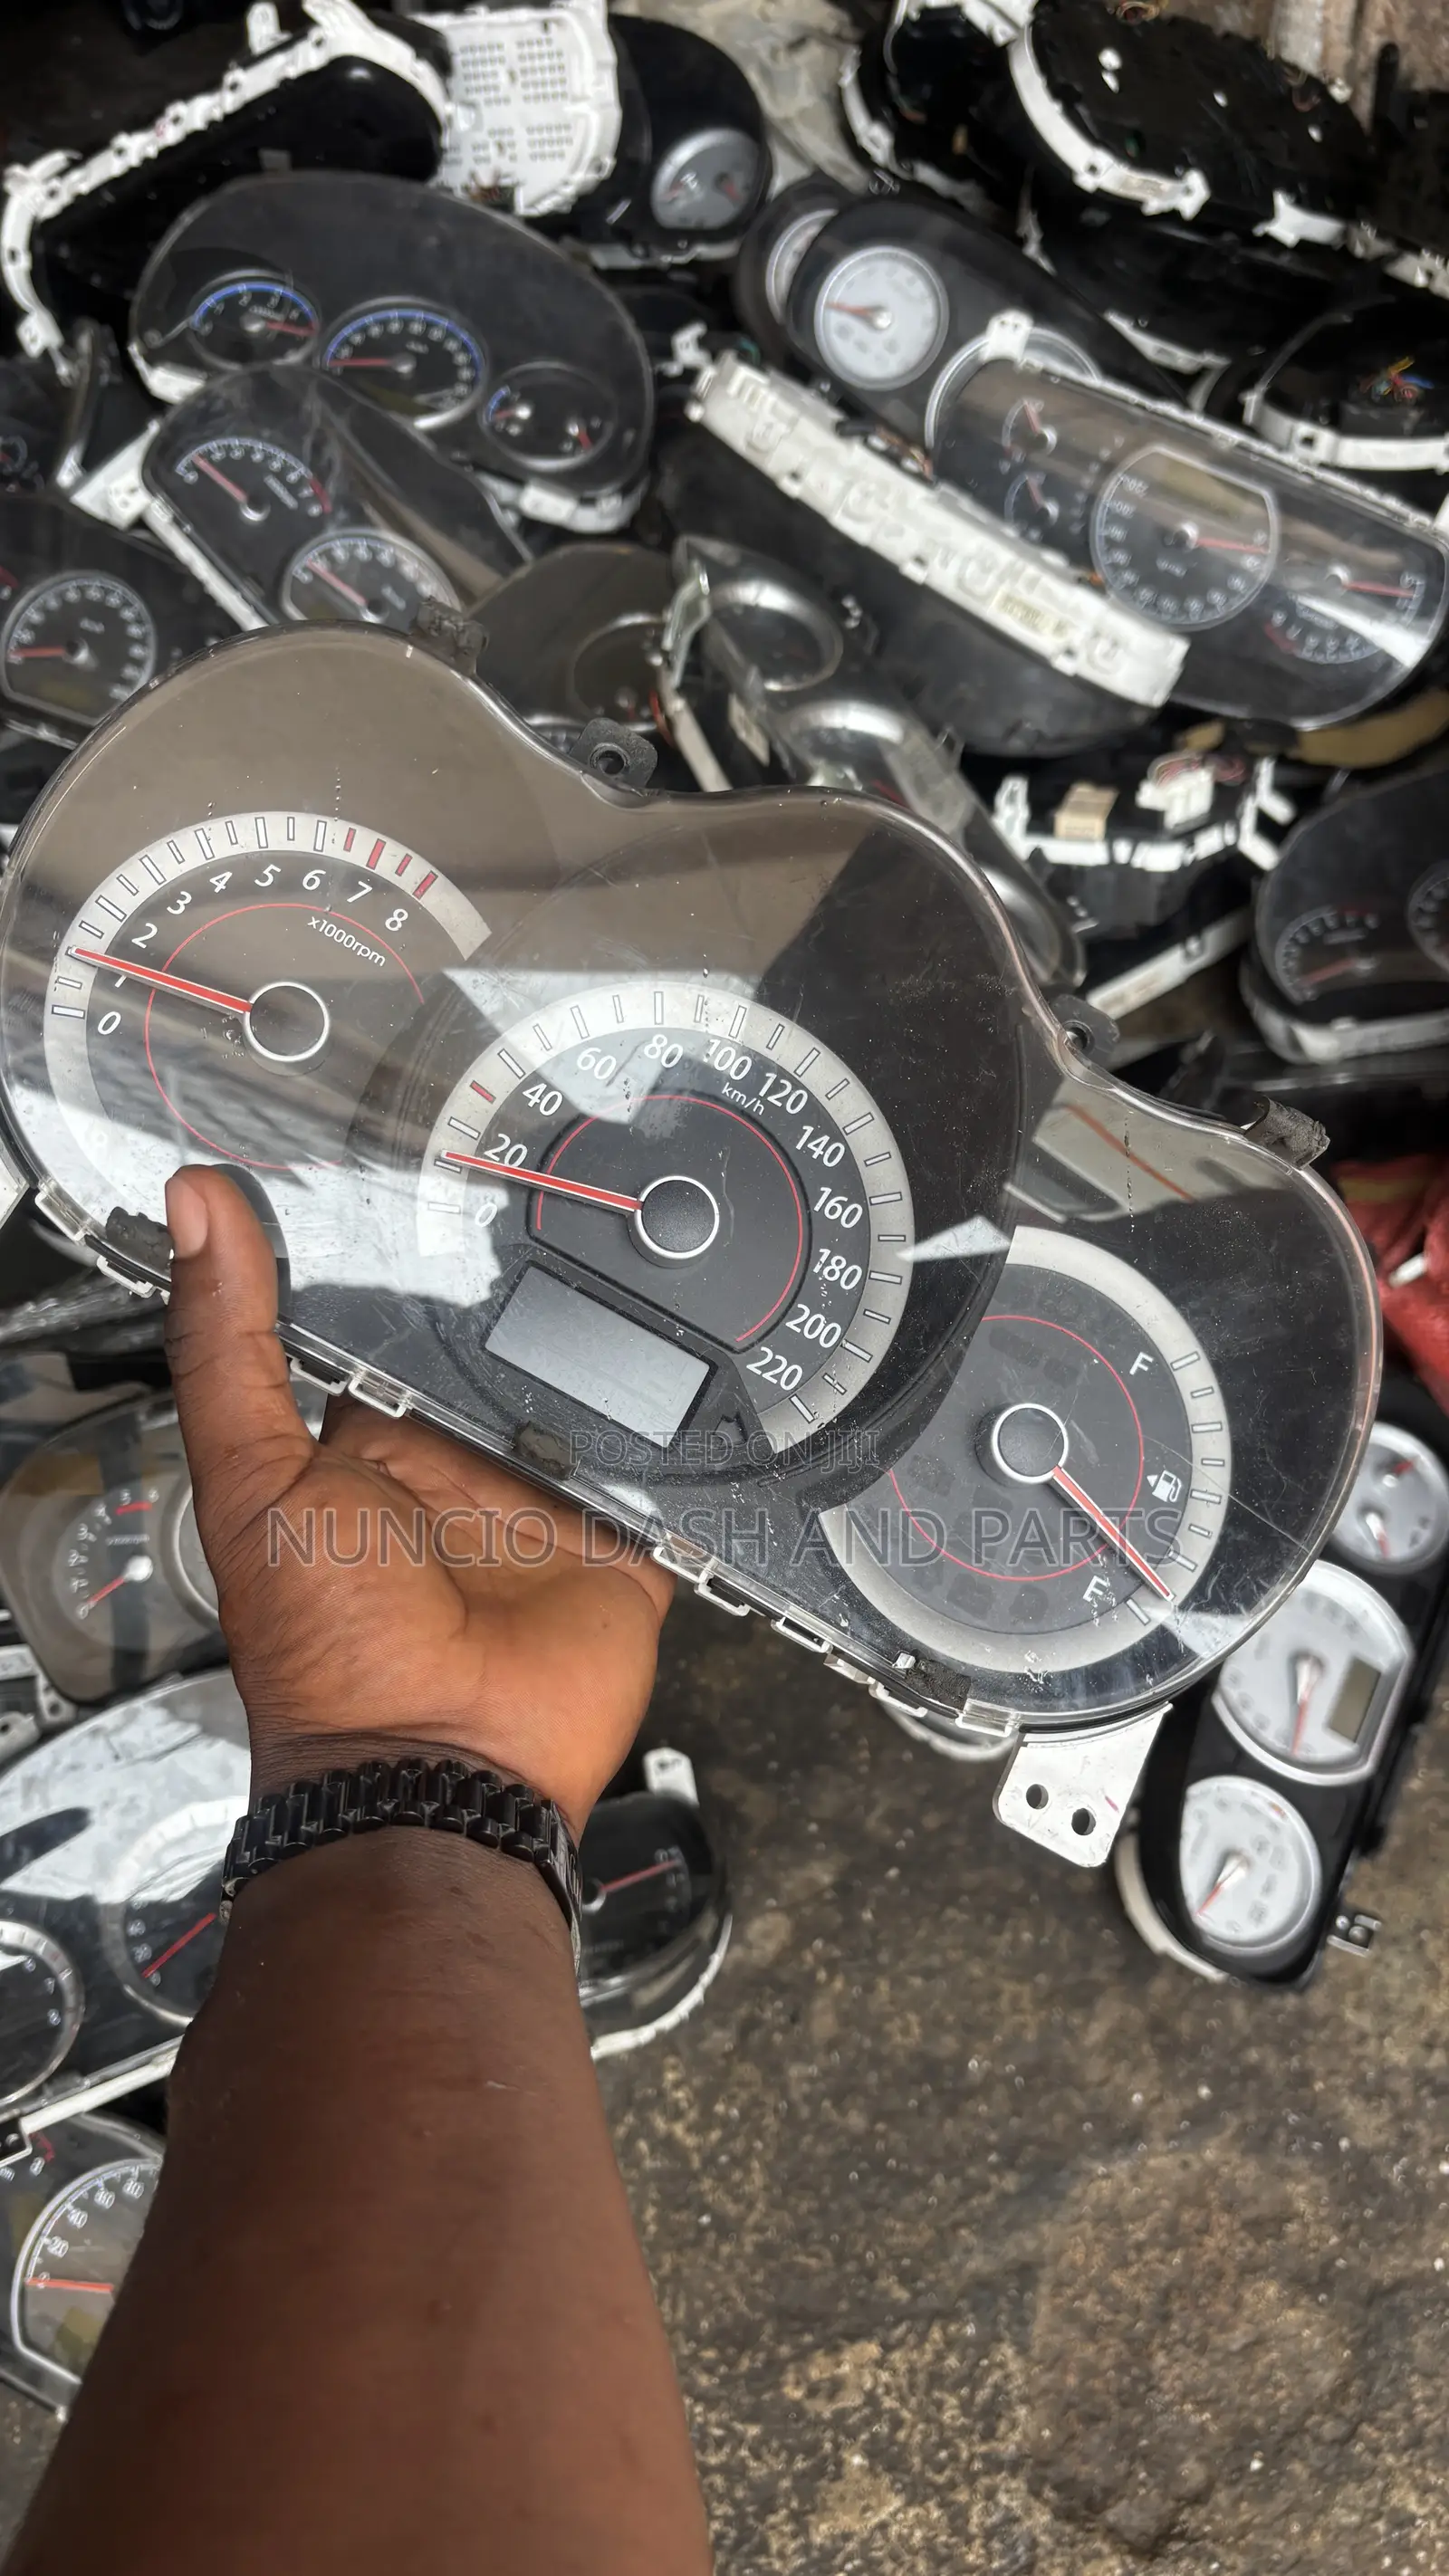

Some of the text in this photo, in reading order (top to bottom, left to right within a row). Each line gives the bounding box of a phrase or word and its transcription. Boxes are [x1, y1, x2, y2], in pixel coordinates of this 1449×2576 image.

[209, 870, 233, 894] 4
[254, 864, 281, 888] 5
[302, 868, 325, 891] 6
[346, 881, 372, 904] 7
[167, 891, 192, 915] 3
[131, 923, 158, 948] 2
[385, 908, 408, 932] 8
[307, 915, 386, 967] x1000rpm
[97, 1010, 122, 1036] 0
[576, 1047, 617, 1080] 60
[643, 1034, 684, 1068] 80
[702, 1039, 753, 1080] 100
[523, 1083, 563, 1117] 40
[721, 1083, 765, 1116] km/h
[756, 1073, 809, 1115] 120
[484, 1134, 528, 1167] 20
[795, 1125, 846, 1168] 140
[475, 1202, 498, 1227] 0
[813, 1187, 863, 1229] 160
[813, 1248, 863, 1291] 180
[785, 1303, 842, 1349] 200
[746, 1346, 803, 1392] 220
[1129, 1352, 1155, 1375] F
[1082, 1575, 1110, 1604] E
